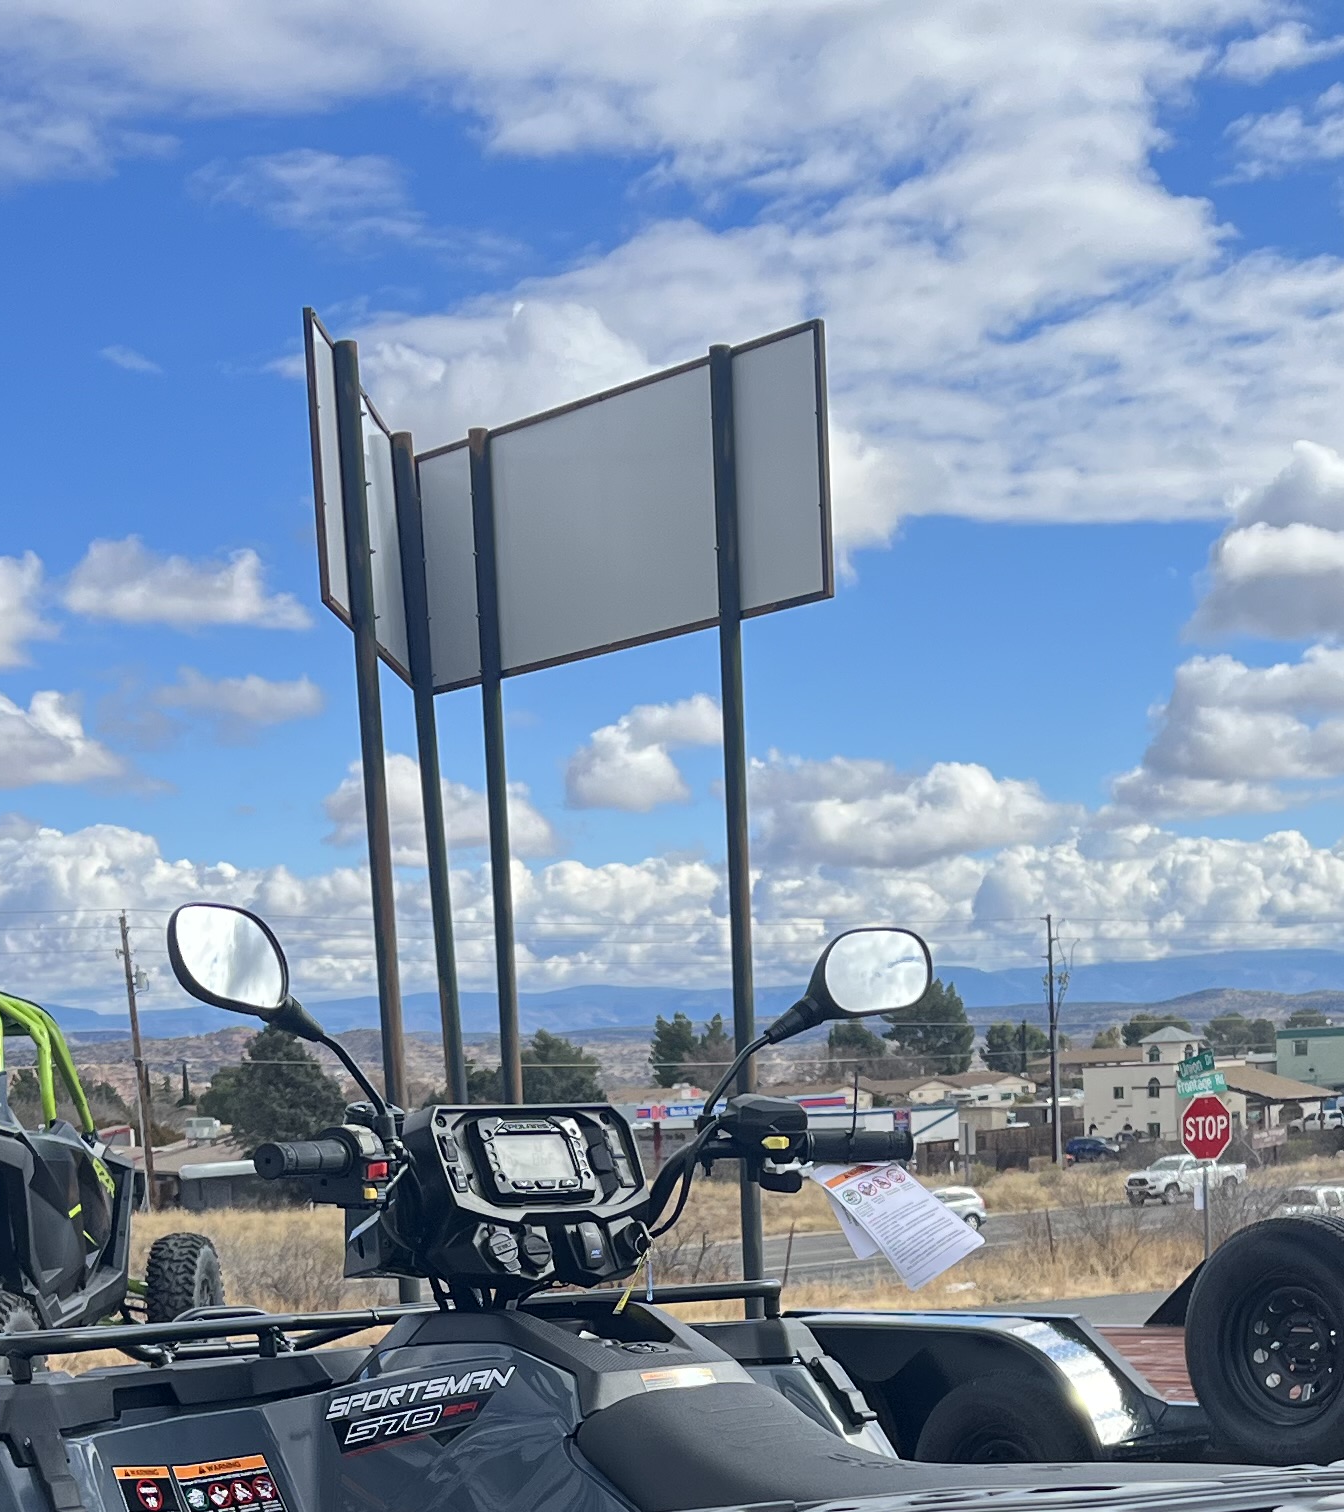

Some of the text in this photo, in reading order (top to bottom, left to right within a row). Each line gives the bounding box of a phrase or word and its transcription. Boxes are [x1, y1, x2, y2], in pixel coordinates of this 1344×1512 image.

[1180, 1060, 1203, 1077] Union
[1177, 1073, 1225, 1094] Frontage Rd
[1185, 1115, 1228, 1142] STOP
[325, 1365, 517, 1420] SPORTSMAN
[344, 1404, 443, 1445] 570
